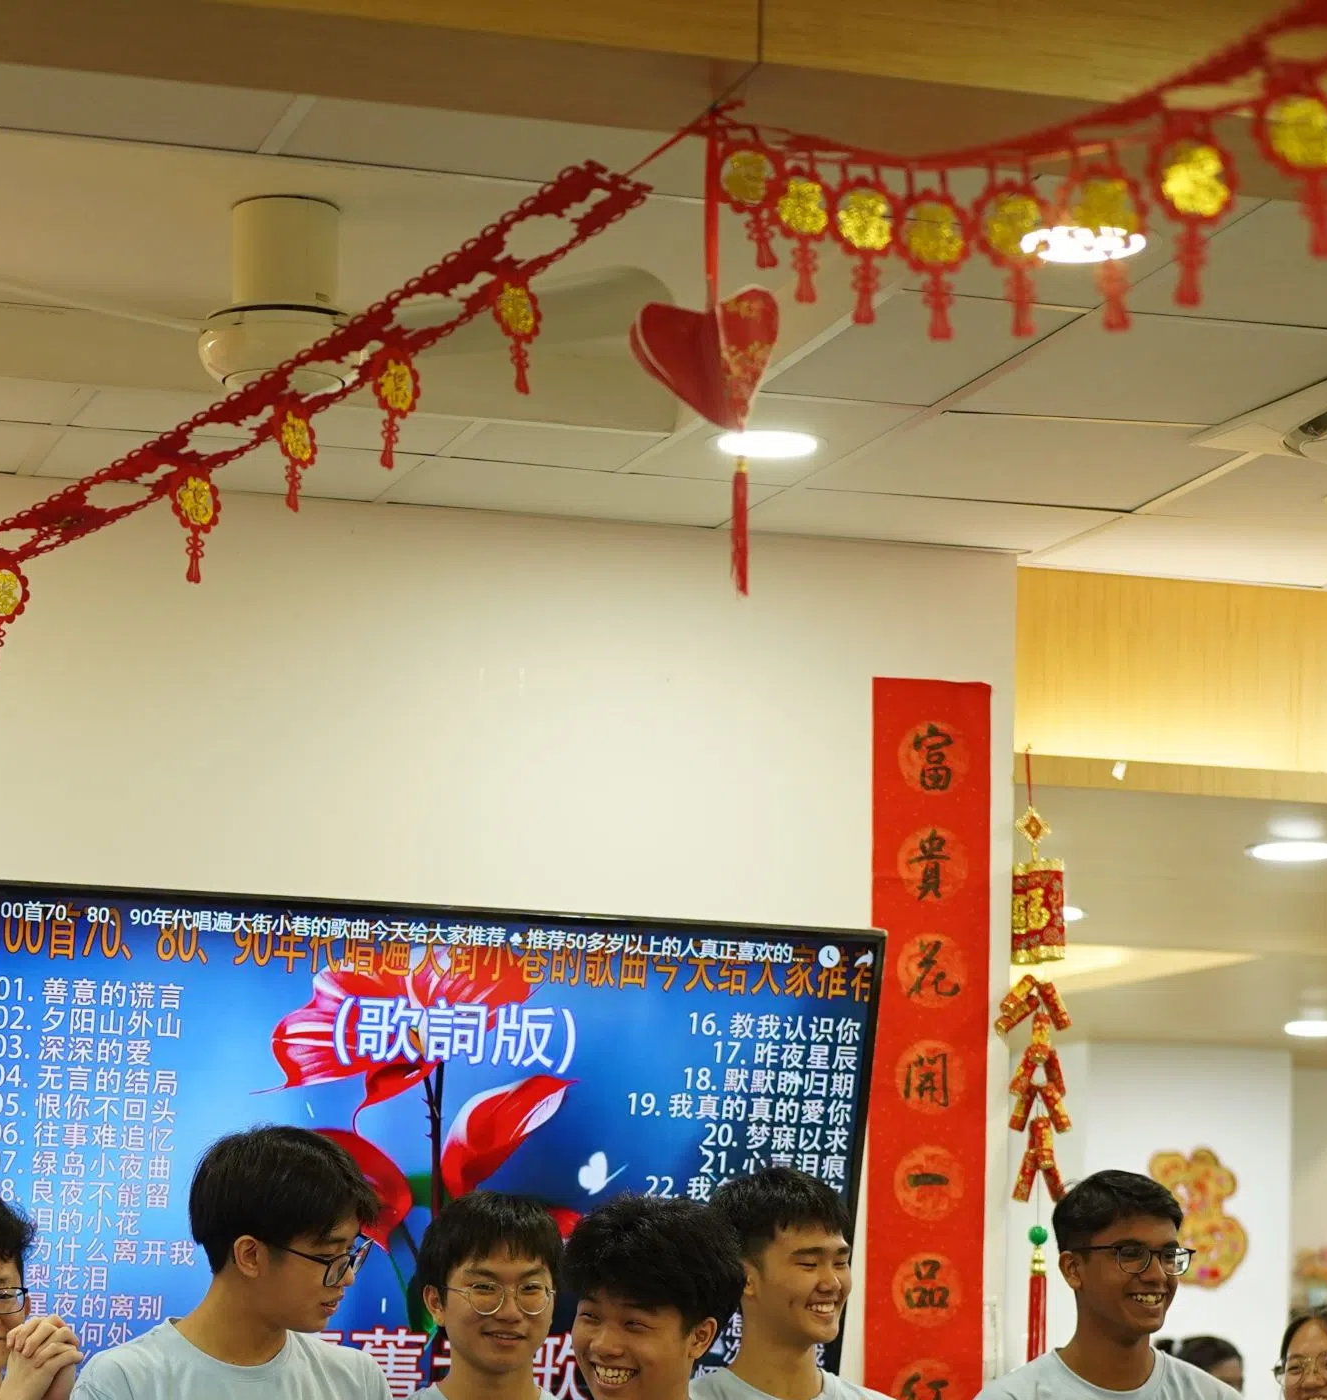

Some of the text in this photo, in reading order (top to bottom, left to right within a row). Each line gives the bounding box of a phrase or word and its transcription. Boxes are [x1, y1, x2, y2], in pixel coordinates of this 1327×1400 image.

[42, 977, 184, 1011] 善意的谎言
[40, 1008, 182, 1039] 夕阳山外山
[335, 996, 576, 1074] (歌詞版)
[688, 1012, 860, 1045] 16. 教我认识你
[38, 1036, 152, 1067] 深深的爱
[713, 1041, 858, 1072] 17. 昨夜星辰
[37, 1066, 178, 1097] 无言的结局
[683, 1067, 717, 1092] 18.
[35, 1095, 176, 1126] 恨你不回头
[628, 1092, 661, 1118] 19.
[33, 1124, 175, 1153] 往事难追忆
[703, 1123, 737, 1148] 20.
[31, 1152, 170, 1181] 绿岛小夜曲
[700, 1150, 735, 1175] 21.
[31, 1180, 170, 1208] 良夜不能留
[646, 1175, 678, 1199] 22.
[28, 1237, 194, 1267] 为什么离开我
[25, 1264, 108, 1292] 梨花泪
[27, 1293, 162, 1320] 星夜的离别
